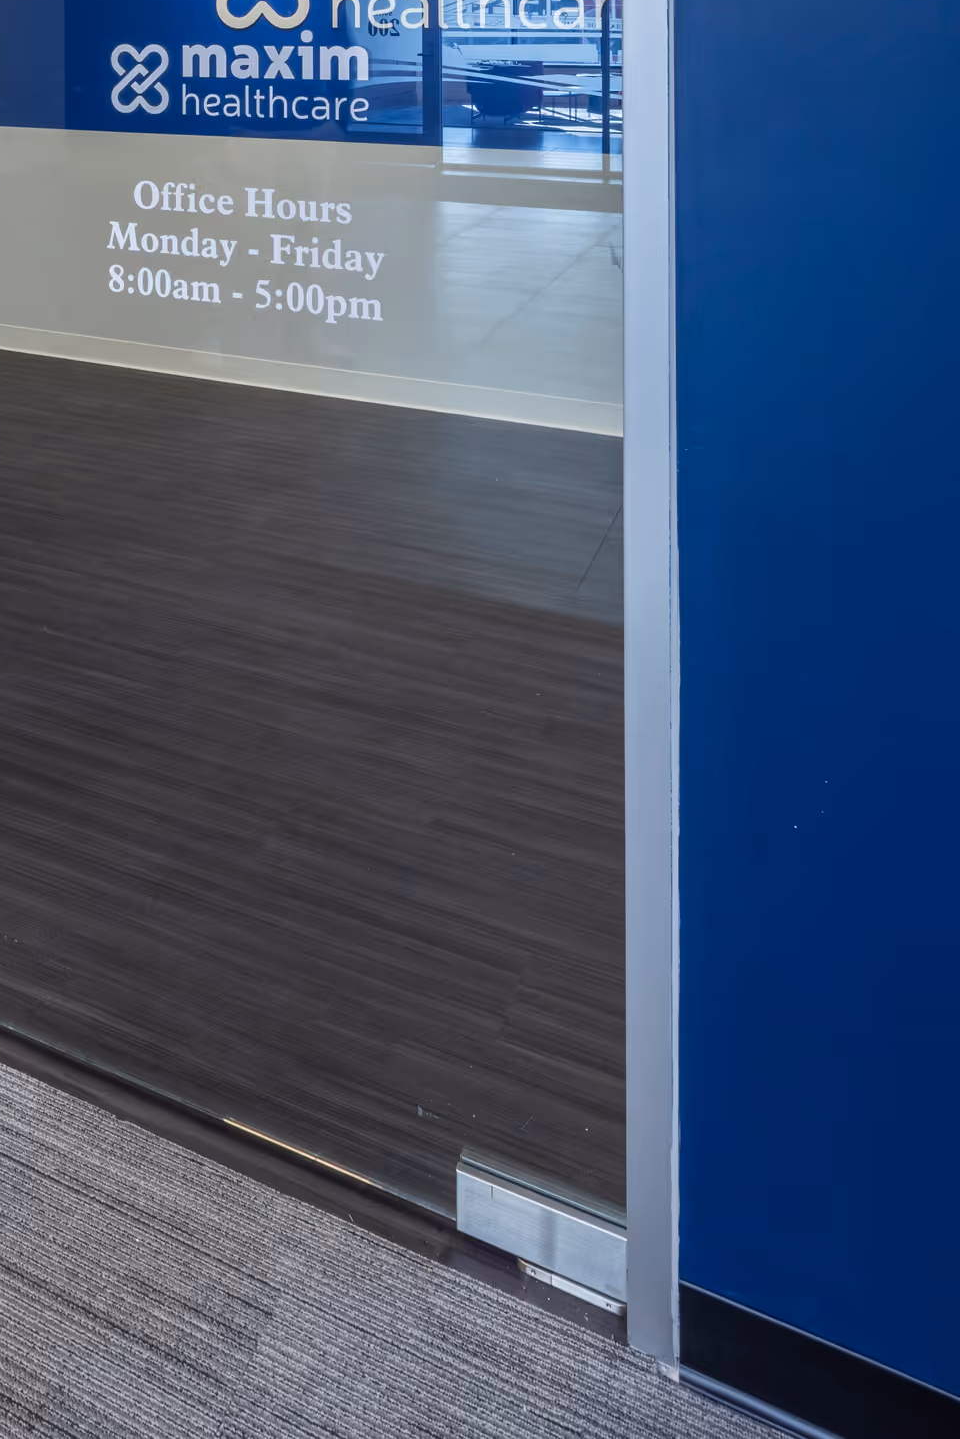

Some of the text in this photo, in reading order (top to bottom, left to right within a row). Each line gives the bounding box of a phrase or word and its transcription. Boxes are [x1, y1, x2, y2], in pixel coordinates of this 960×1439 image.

[182, 30, 369, 81] maxim
[182, 84, 369, 122] healthcare
[133, 180, 353, 225] Office Hours
[107, 221, 237, 266] Monday
[270, 234, 385, 280] Friday
[108, 264, 221, 304] 8:00am
[254, 279, 384, 324] 5:00pm
